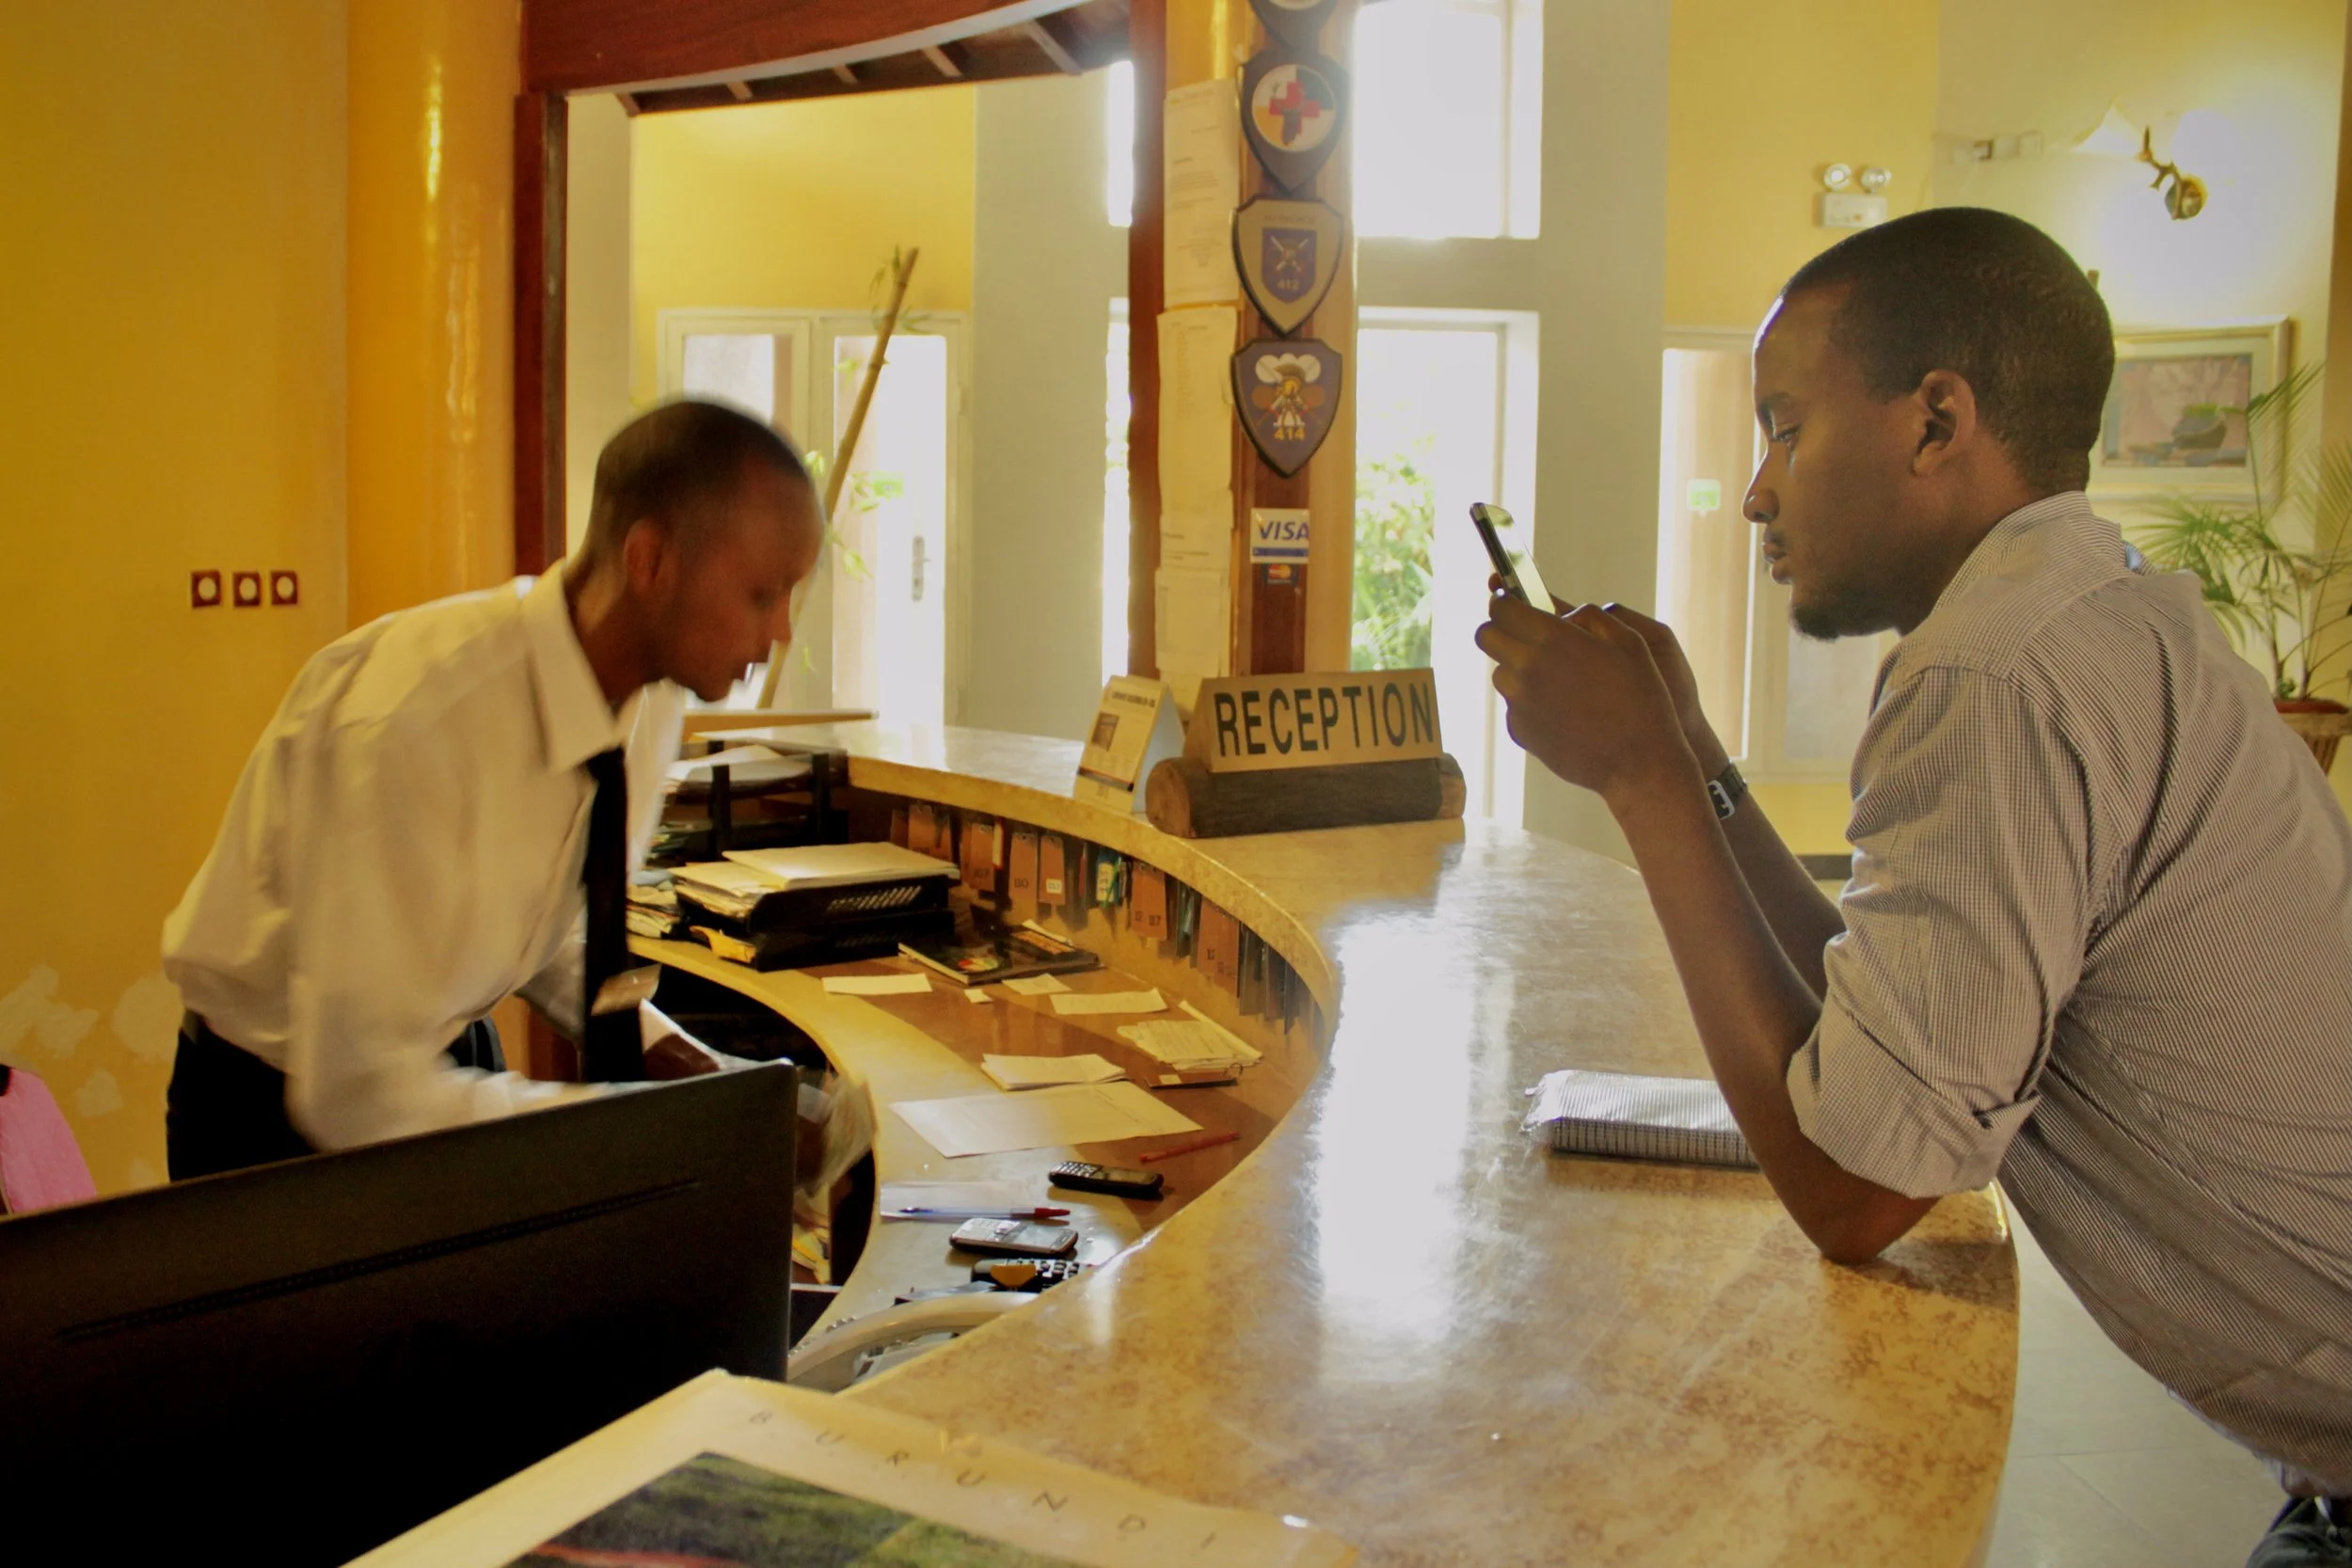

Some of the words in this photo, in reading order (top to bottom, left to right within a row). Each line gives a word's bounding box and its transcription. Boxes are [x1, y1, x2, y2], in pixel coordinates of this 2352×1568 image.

[1274, 427, 1306, 441] 414
[1259, 521, 1310, 541] VISA
[1214, 682, 1434, 757] RECEPTION
[749, 1411, 1216, 1550] BURUNDI
